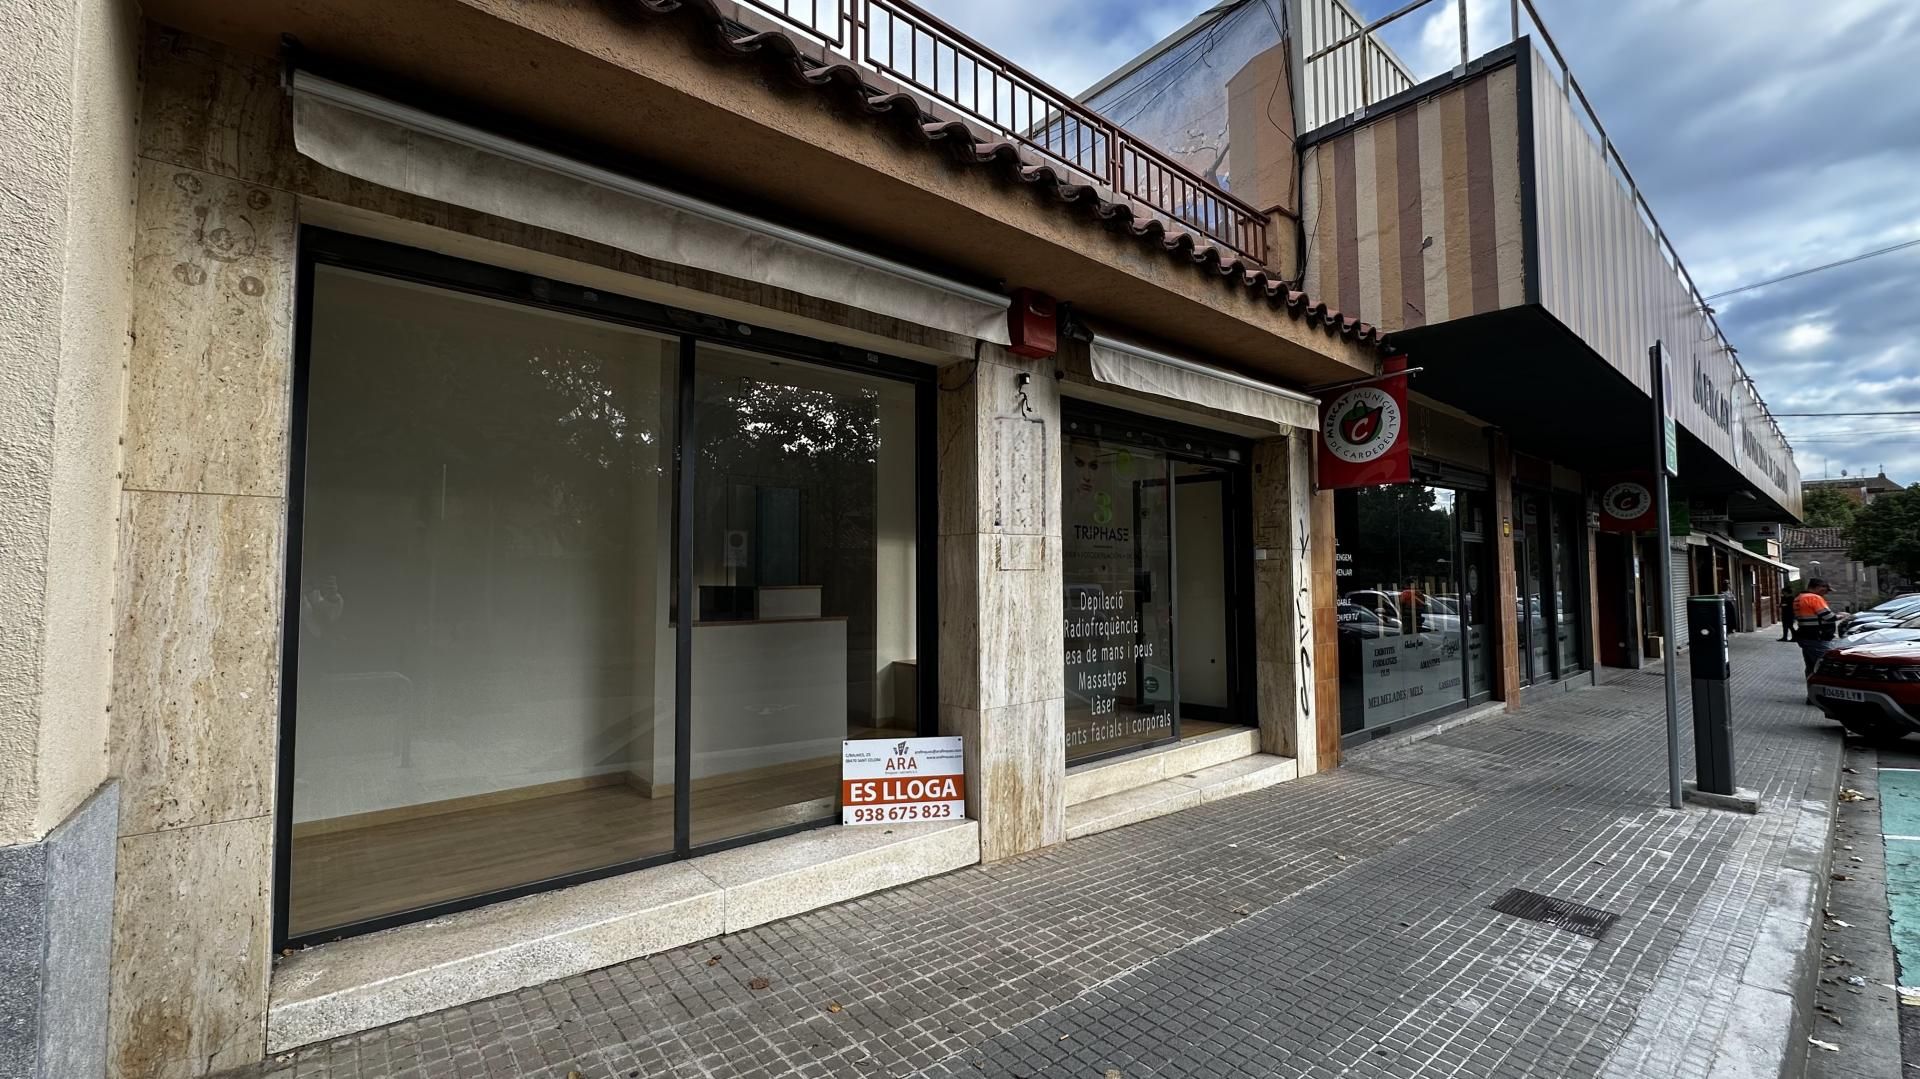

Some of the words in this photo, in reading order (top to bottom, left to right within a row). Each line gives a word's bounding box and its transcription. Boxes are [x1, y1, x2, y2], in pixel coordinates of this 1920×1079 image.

[1326, 396, 1349, 438] MERCAT
[1353, 391, 1397, 428] MUNICIPAL
[1330, 441, 1342, 452] DE
[1343, 431, 1395, 459] CARDEDEU
[1074, 524, 1129, 542] TRIPHASE
[1080, 589, 1124, 616] Depilació
[1064, 616, 1139, 641] Radiofreqüència
[1086, 643, 1097, 663] de
[1101, 645, 1124, 661] mans
[1134, 642, 1153, 664] peus
[1078, 669, 1127, 691] Massatges
[1091, 694, 1116, 716] Làser
[1368, 690, 1406, 709] MELMELADES
[1409, 685, 1424, 698] MELS
[1091, 718, 1122, 742] facials
[1132, 708, 1171, 736] corporals
[885, 757, 917, 771] ARA
[850, 782, 877, 802] ES
[882, 778, 957, 801] LLOGA
[854, 808, 884, 822] 938
[888, 805, 918, 820] 675
[922, 804, 951, 818] 823
